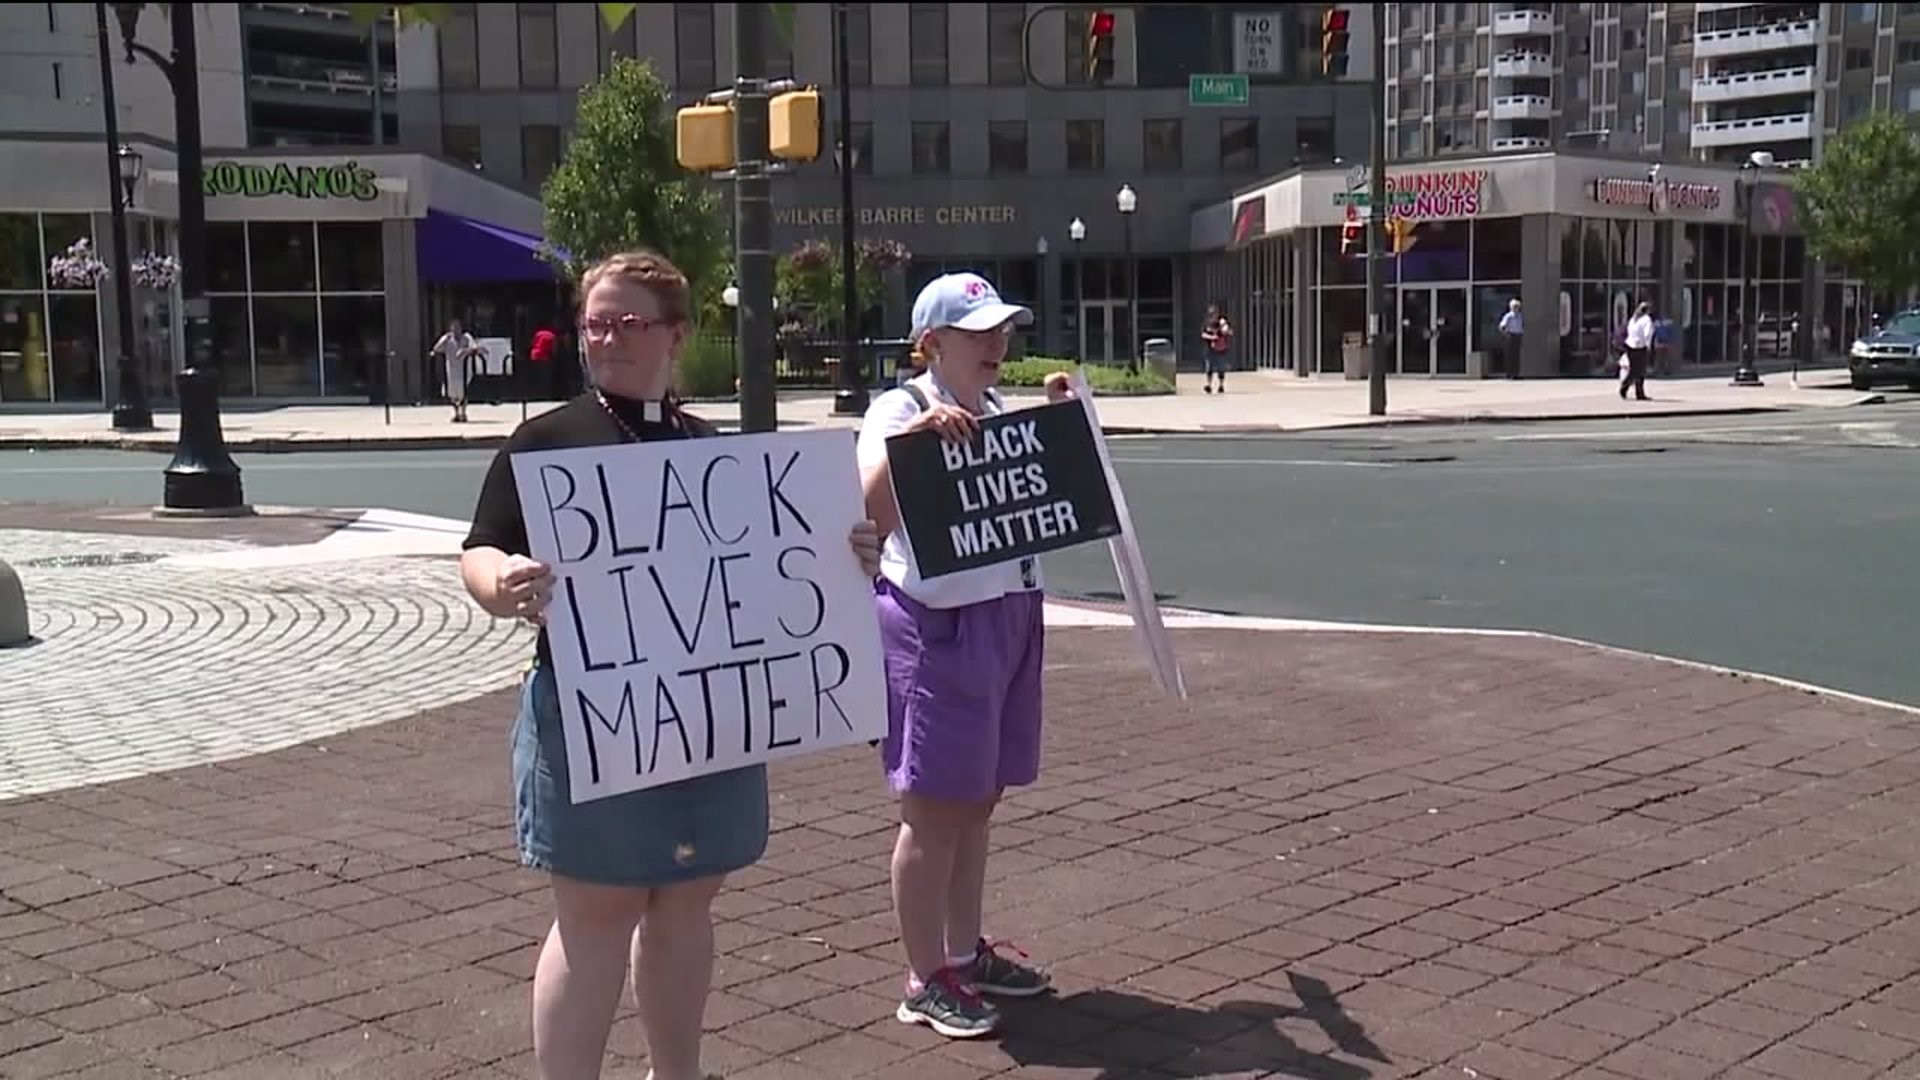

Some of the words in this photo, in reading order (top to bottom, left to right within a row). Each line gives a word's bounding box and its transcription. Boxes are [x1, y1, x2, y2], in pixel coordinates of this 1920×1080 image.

[1246, 19, 1270, 33] NO
[1202, 79, 1234, 95] Main
[936, 206, 1015, 224] CENTER
[940, 420, 1045, 472] BLACK
[539, 450, 812, 563] BLACK
[957, 462, 1048, 512] LIVES
[949, 500, 1080, 558] MATTER
[565, 546, 826, 672] LIVES
[576, 642, 853, 785] MATTER
